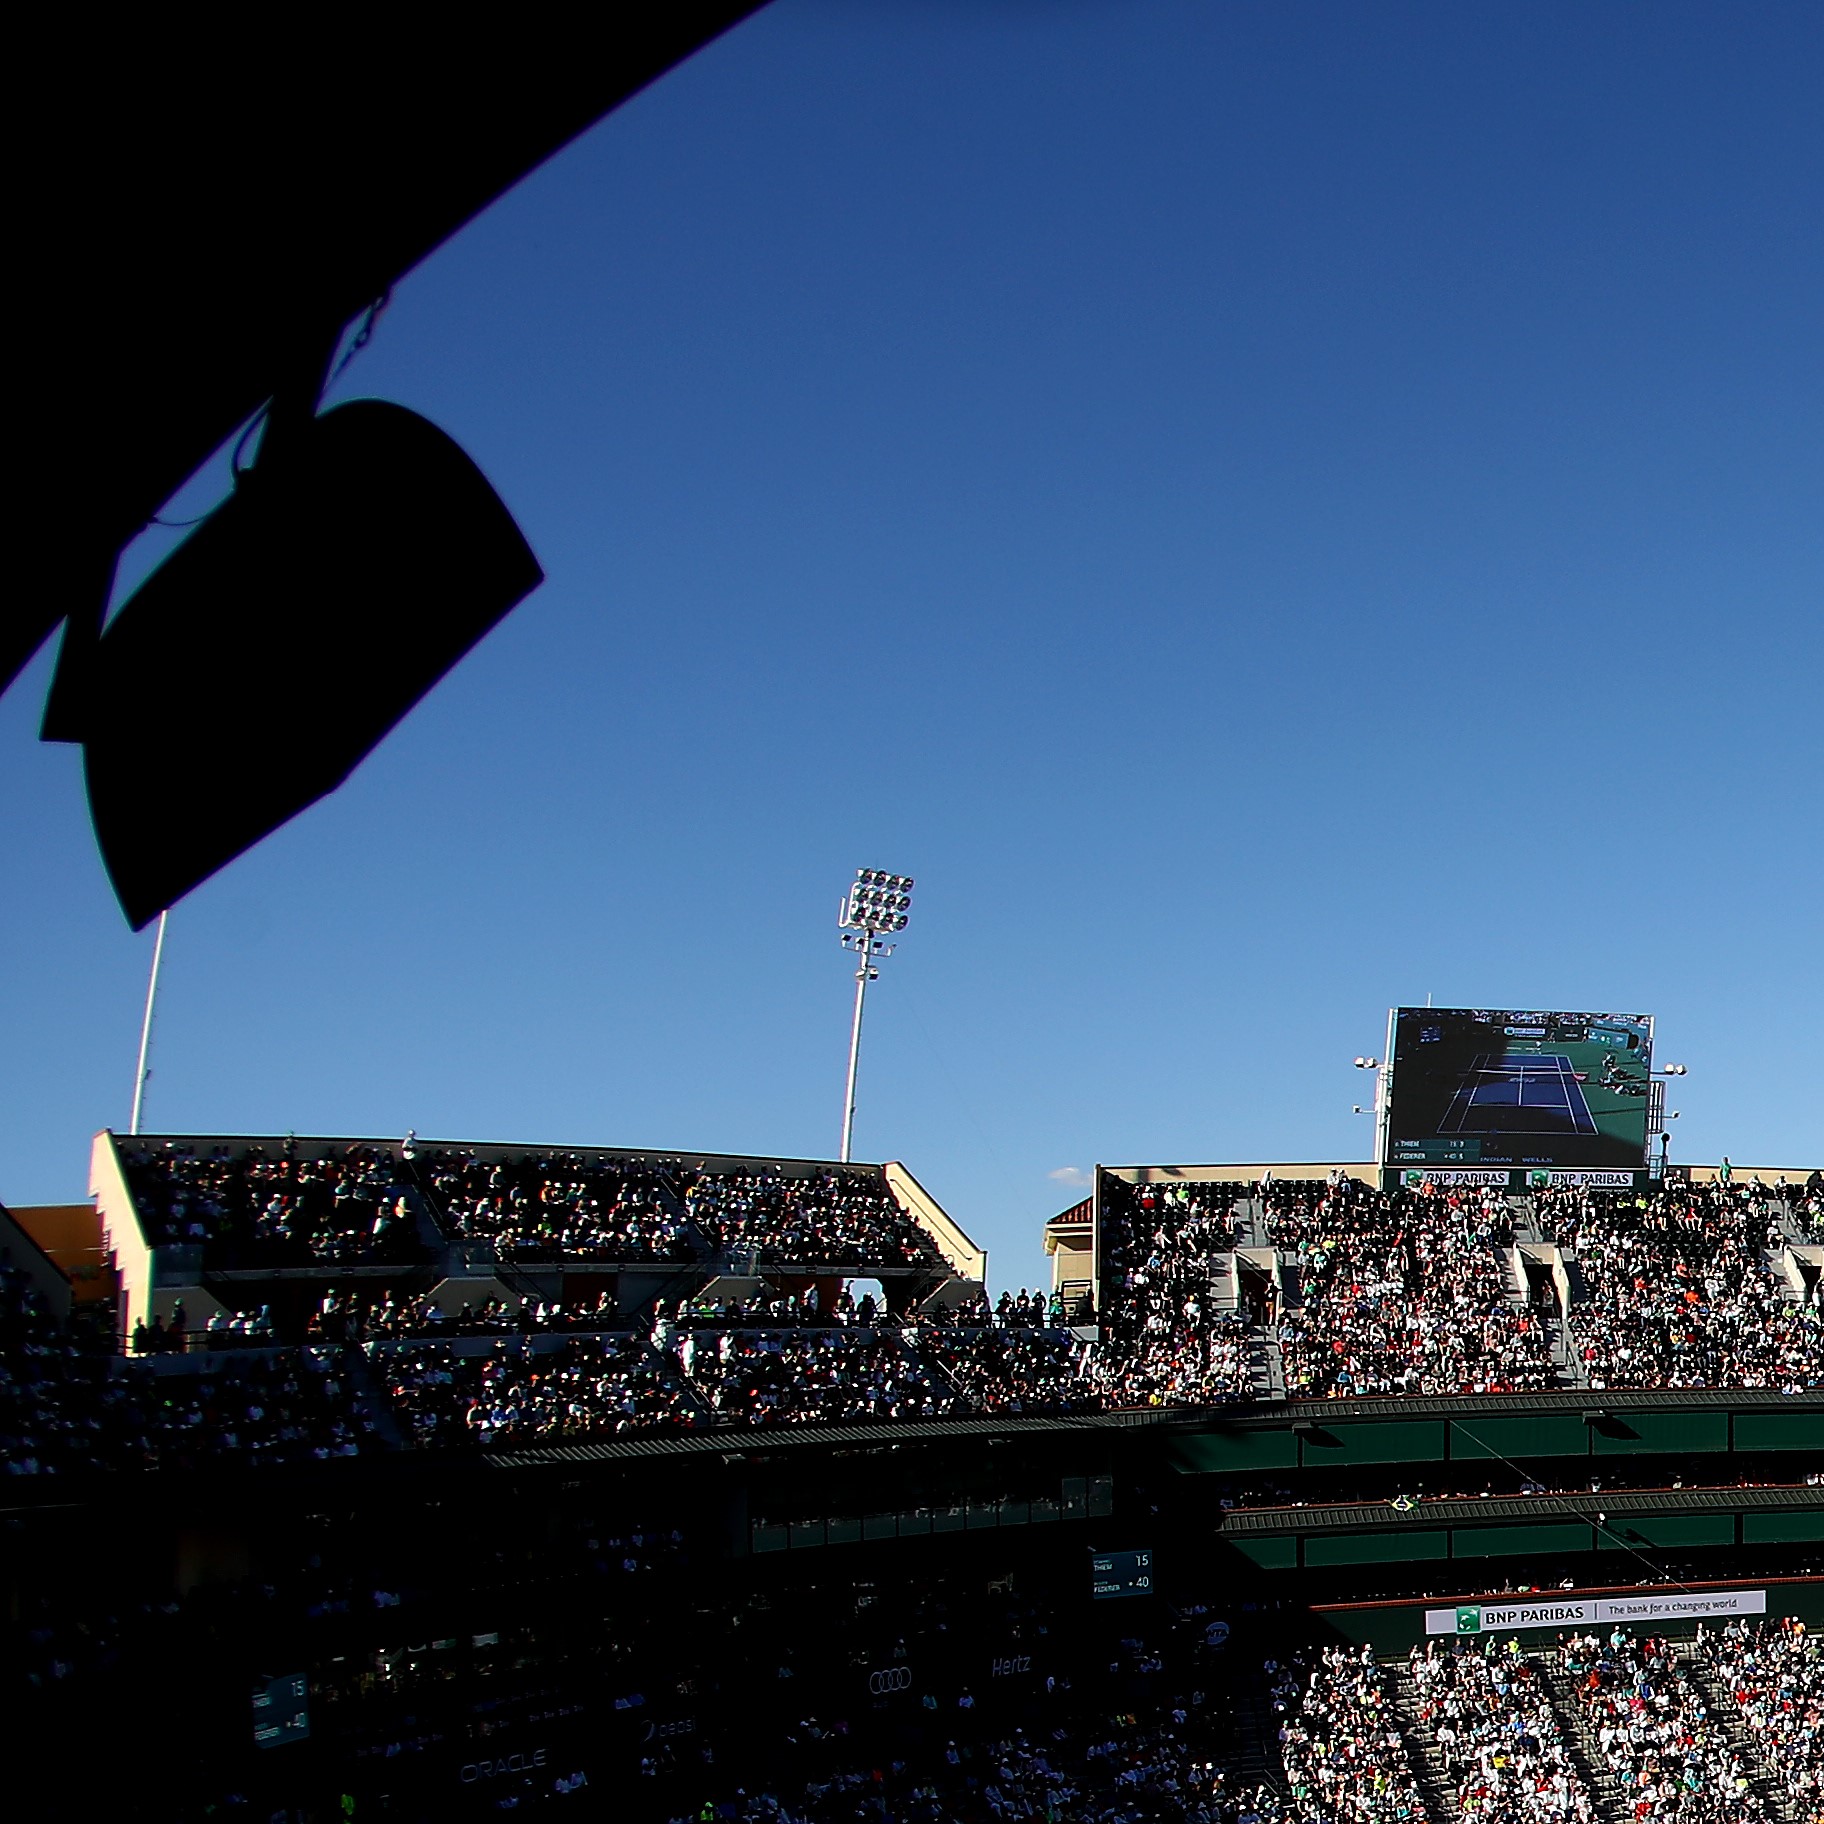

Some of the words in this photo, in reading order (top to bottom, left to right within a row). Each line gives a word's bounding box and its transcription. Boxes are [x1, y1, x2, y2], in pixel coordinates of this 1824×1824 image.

[1551, 1173, 1576, 1184] BNP
[1580, 1173, 1629, 1185] PARIBAS
[1135, 1554, 1149, 1567] 15
[1135, 1576, 1149, 1588] 40
[1485, 1610, 1517, 1625] BNP
[1520, 1606, 1585, 1622] PARIBAS
[1608, 1604, 1625, 1615] The
[1627, 1603, 1648, 1614] bank
[1649, 1602, 1662, 1615] for
[1672, 1601, 1711, 1614] changing
[1712, 1598, 1738, 1610] world
[992, 1654, 1032, 1678] Hertz
[659, 1714, 697, 1738] pepsi
[460, 1748, 548, 1783] ORACLE
